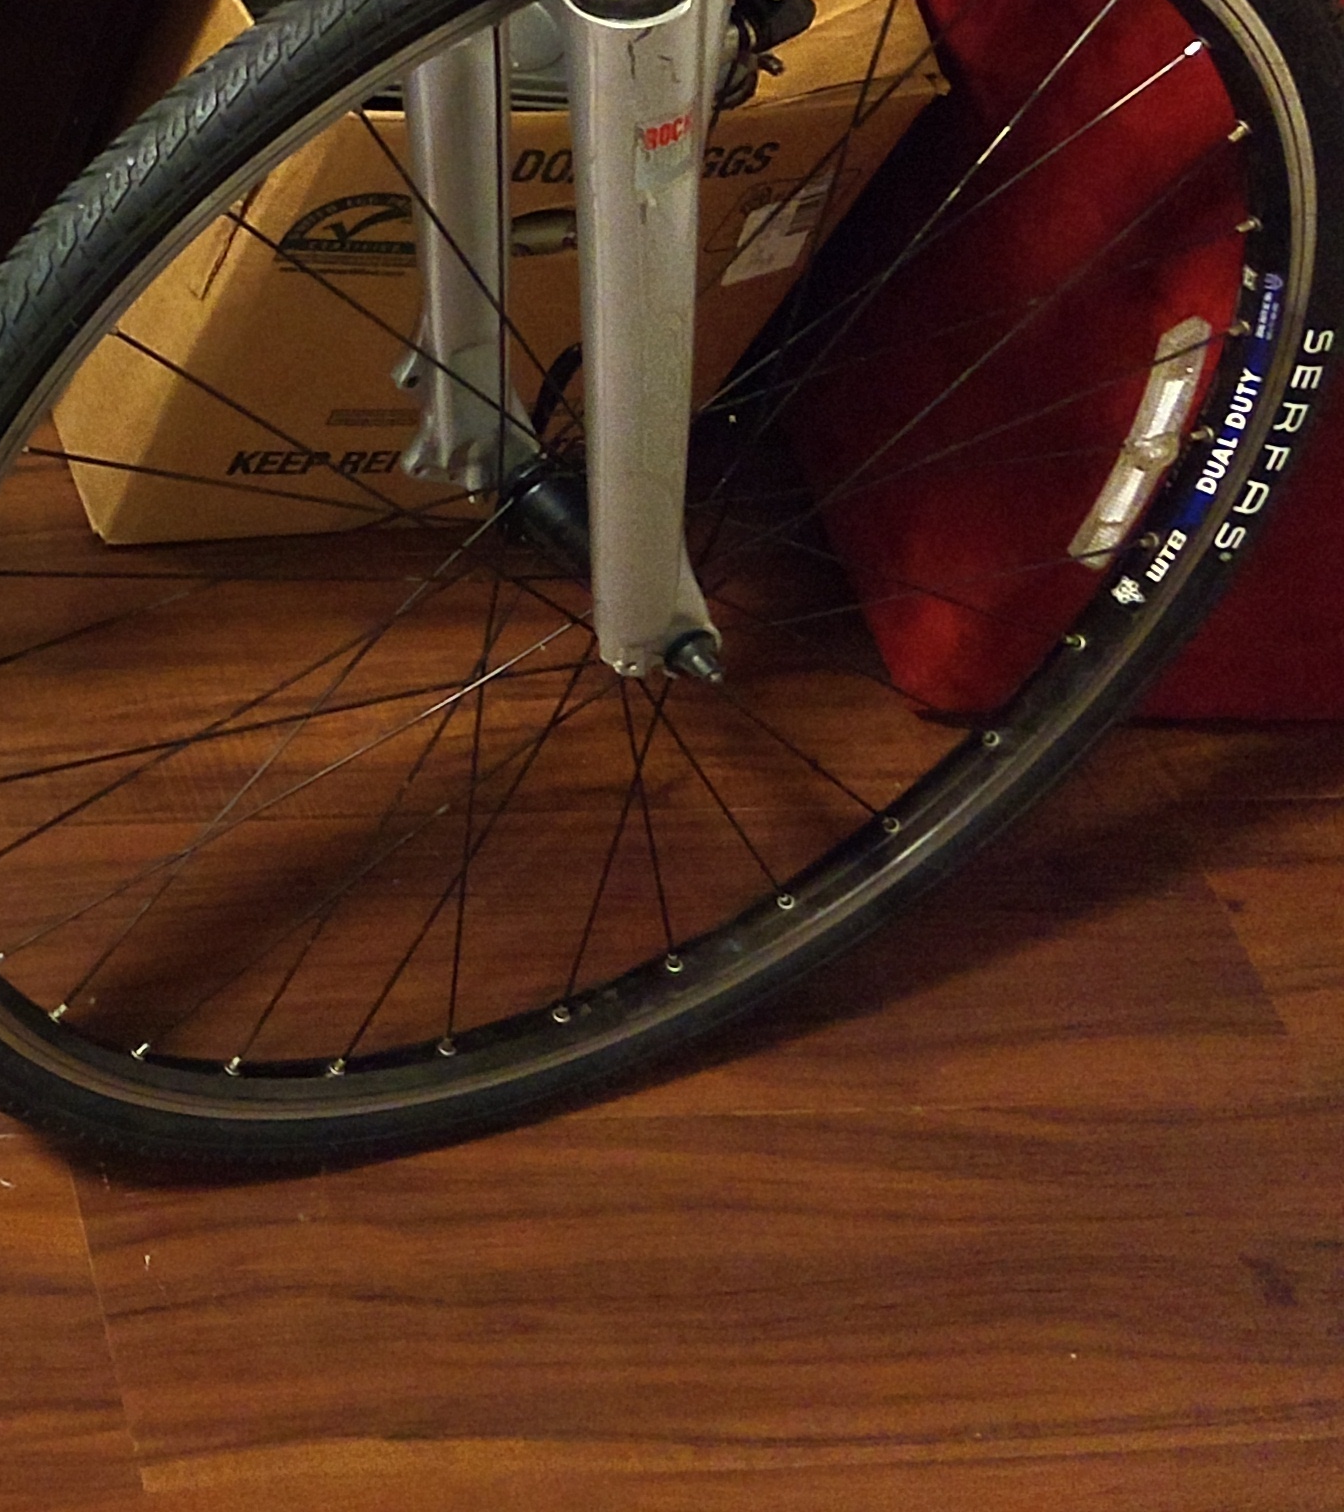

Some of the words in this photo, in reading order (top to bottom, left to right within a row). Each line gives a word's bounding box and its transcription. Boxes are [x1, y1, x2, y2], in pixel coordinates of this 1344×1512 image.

[226, 450, 331, 475] KEEP
[1147, 529, 1188, 582] WTB
[1196, 437, 1238, 495] DUAL
[1224, 367, 1262, 430] DUTY
[1213, 328, 1334, 551] SERFAS
